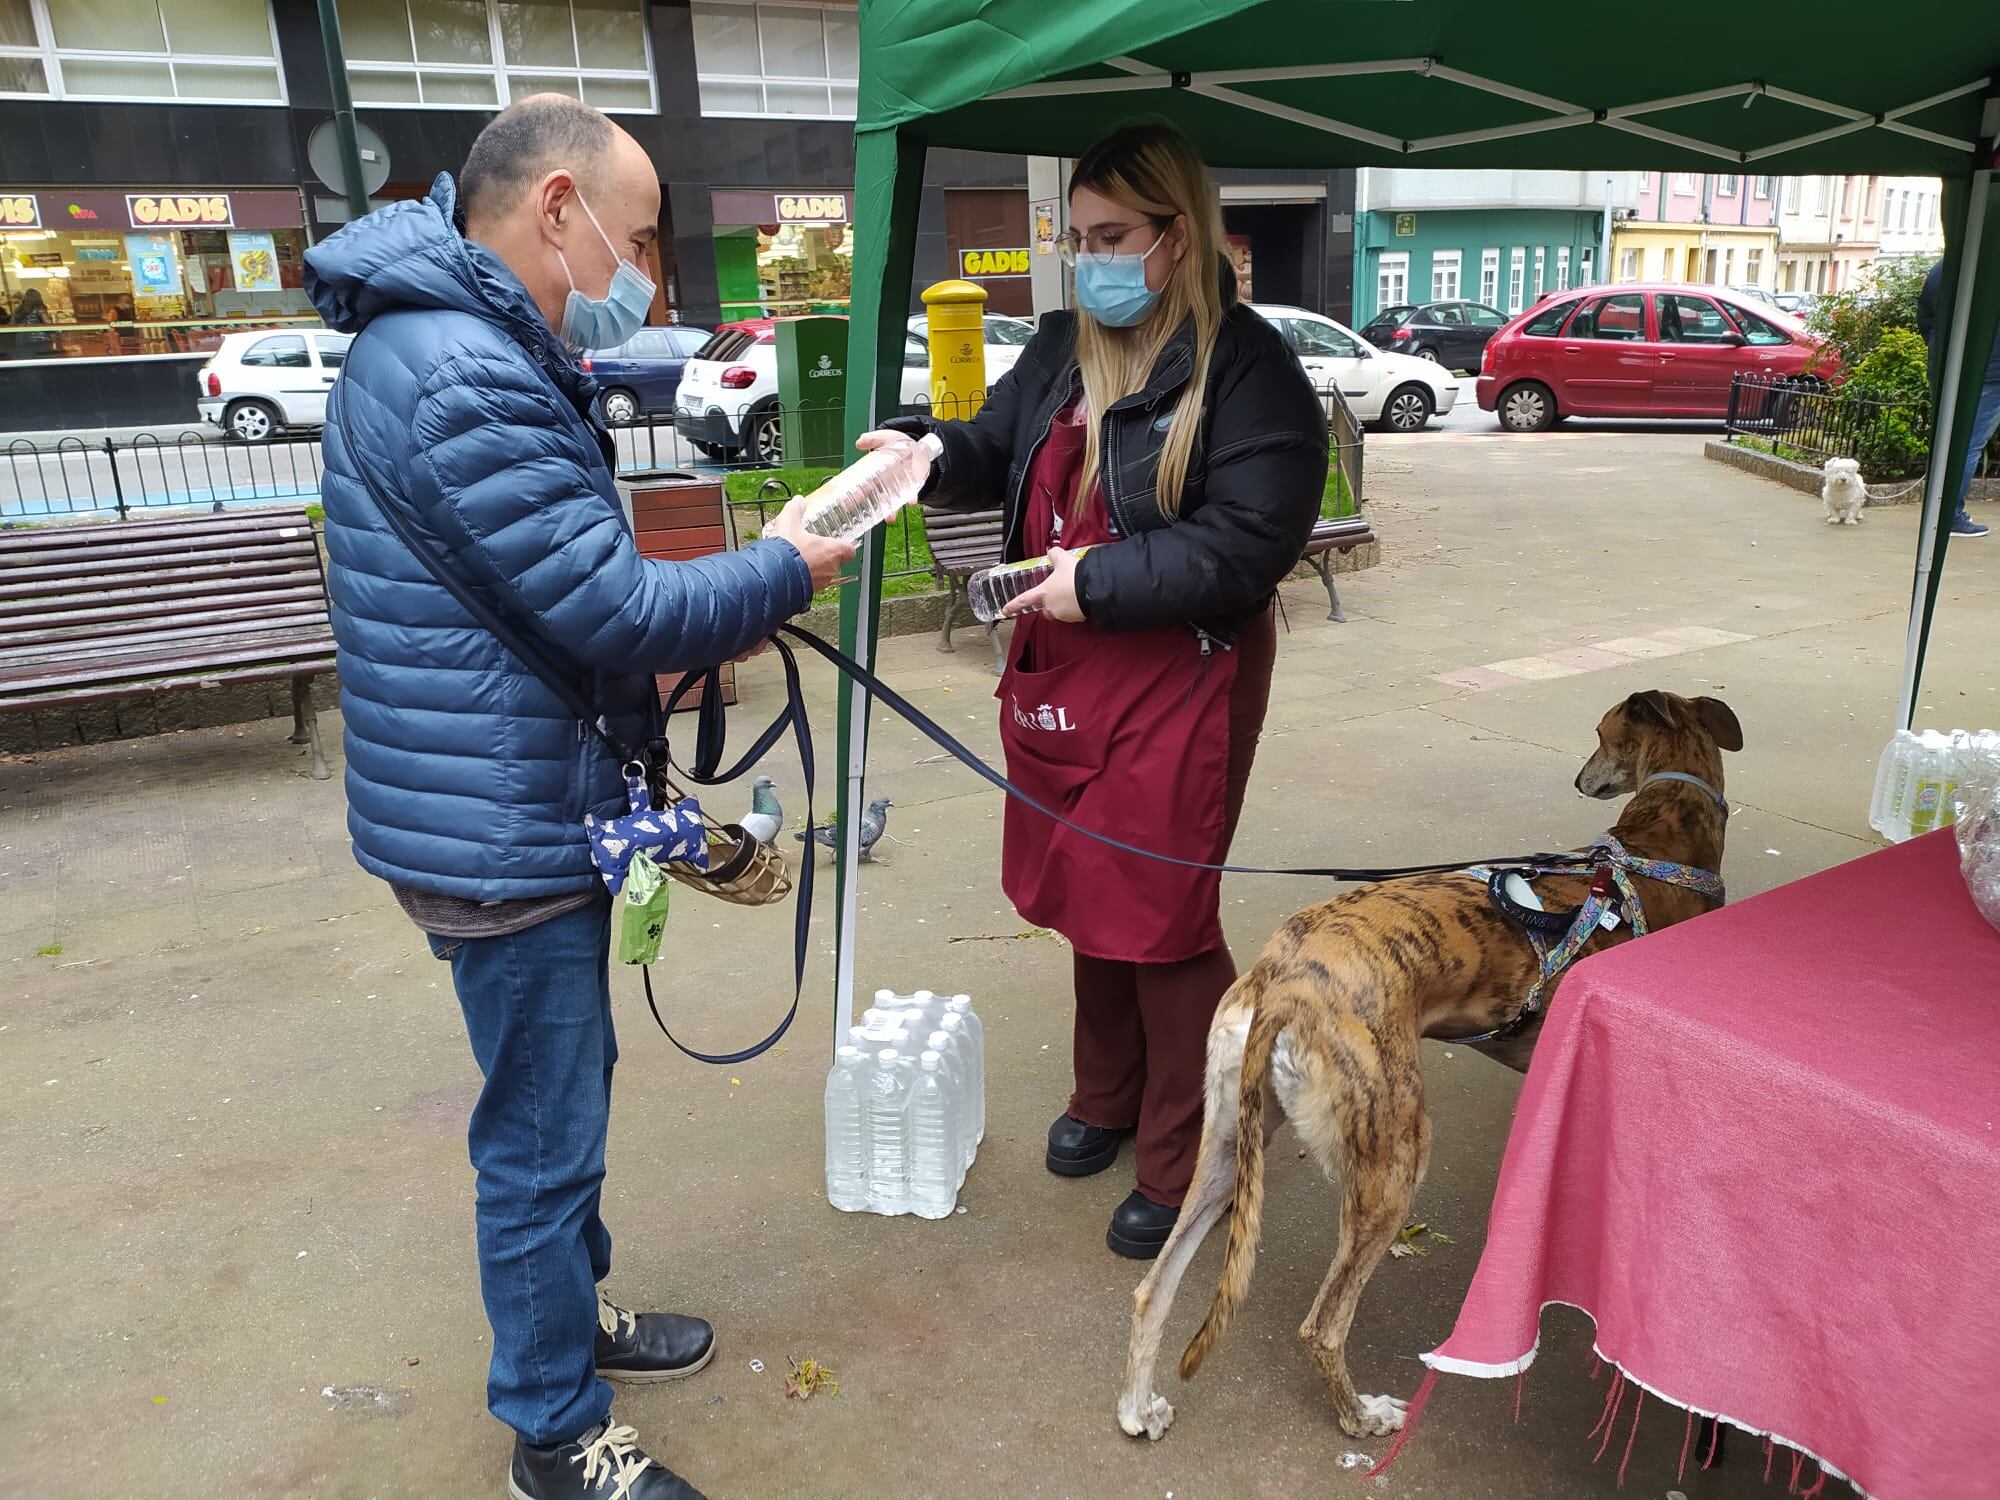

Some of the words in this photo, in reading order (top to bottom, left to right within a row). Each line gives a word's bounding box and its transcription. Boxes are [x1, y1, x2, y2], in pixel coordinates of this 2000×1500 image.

[0, 198, 35, 223] IS
[134, 197, 228, 224] GADIS
[780, 198, 844, 219] GADIS
[964, 250, 1030, 274] GADIS
[808, 367, 843, 378] CORREOS
